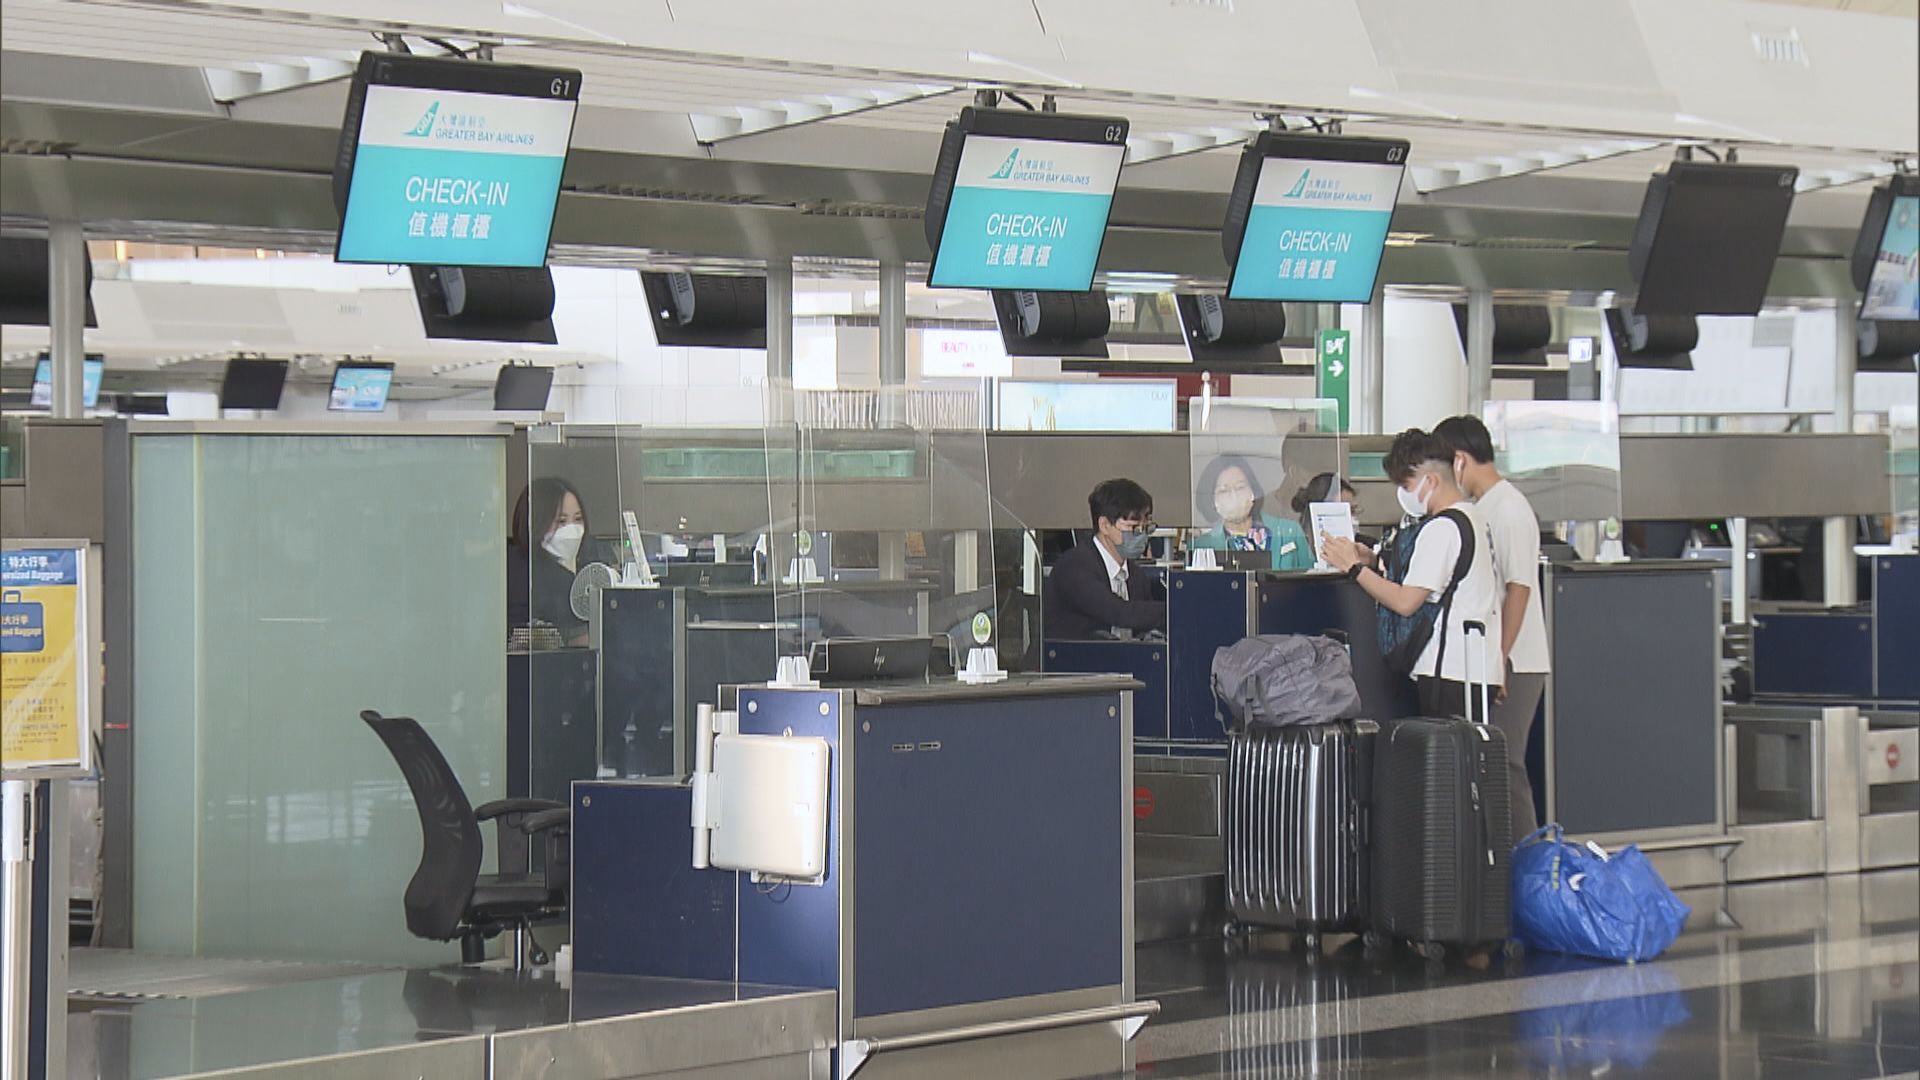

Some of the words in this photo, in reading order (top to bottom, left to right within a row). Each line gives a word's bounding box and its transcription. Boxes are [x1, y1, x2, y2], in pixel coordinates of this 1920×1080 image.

[550, 78, 570, 96] G1
[435, 129, 476, 141] GREATER
[478, 131, 495, 142] BAY
[496, 132, 535, 145] AIRLINES
[1105, 126, 1122, 141] G2
[1386, 148, 1403, 162] G3
[1013, 172, 1045, 182] GREATER
[1046, 173, 1059, 183] BAY
[1059, 174, 1090, 185] AIRLINES
[405, 176, 510, 207] CHECK-IN
[408, 211, 492, 239] 值機櫃檯
[986, 213, 1068, 239] CHECK-IN
[1279, 229, 1352, 253] CHECK-IN
[31, 570, 64, 581] Baggage
[873, 647, 886, 672] hp
